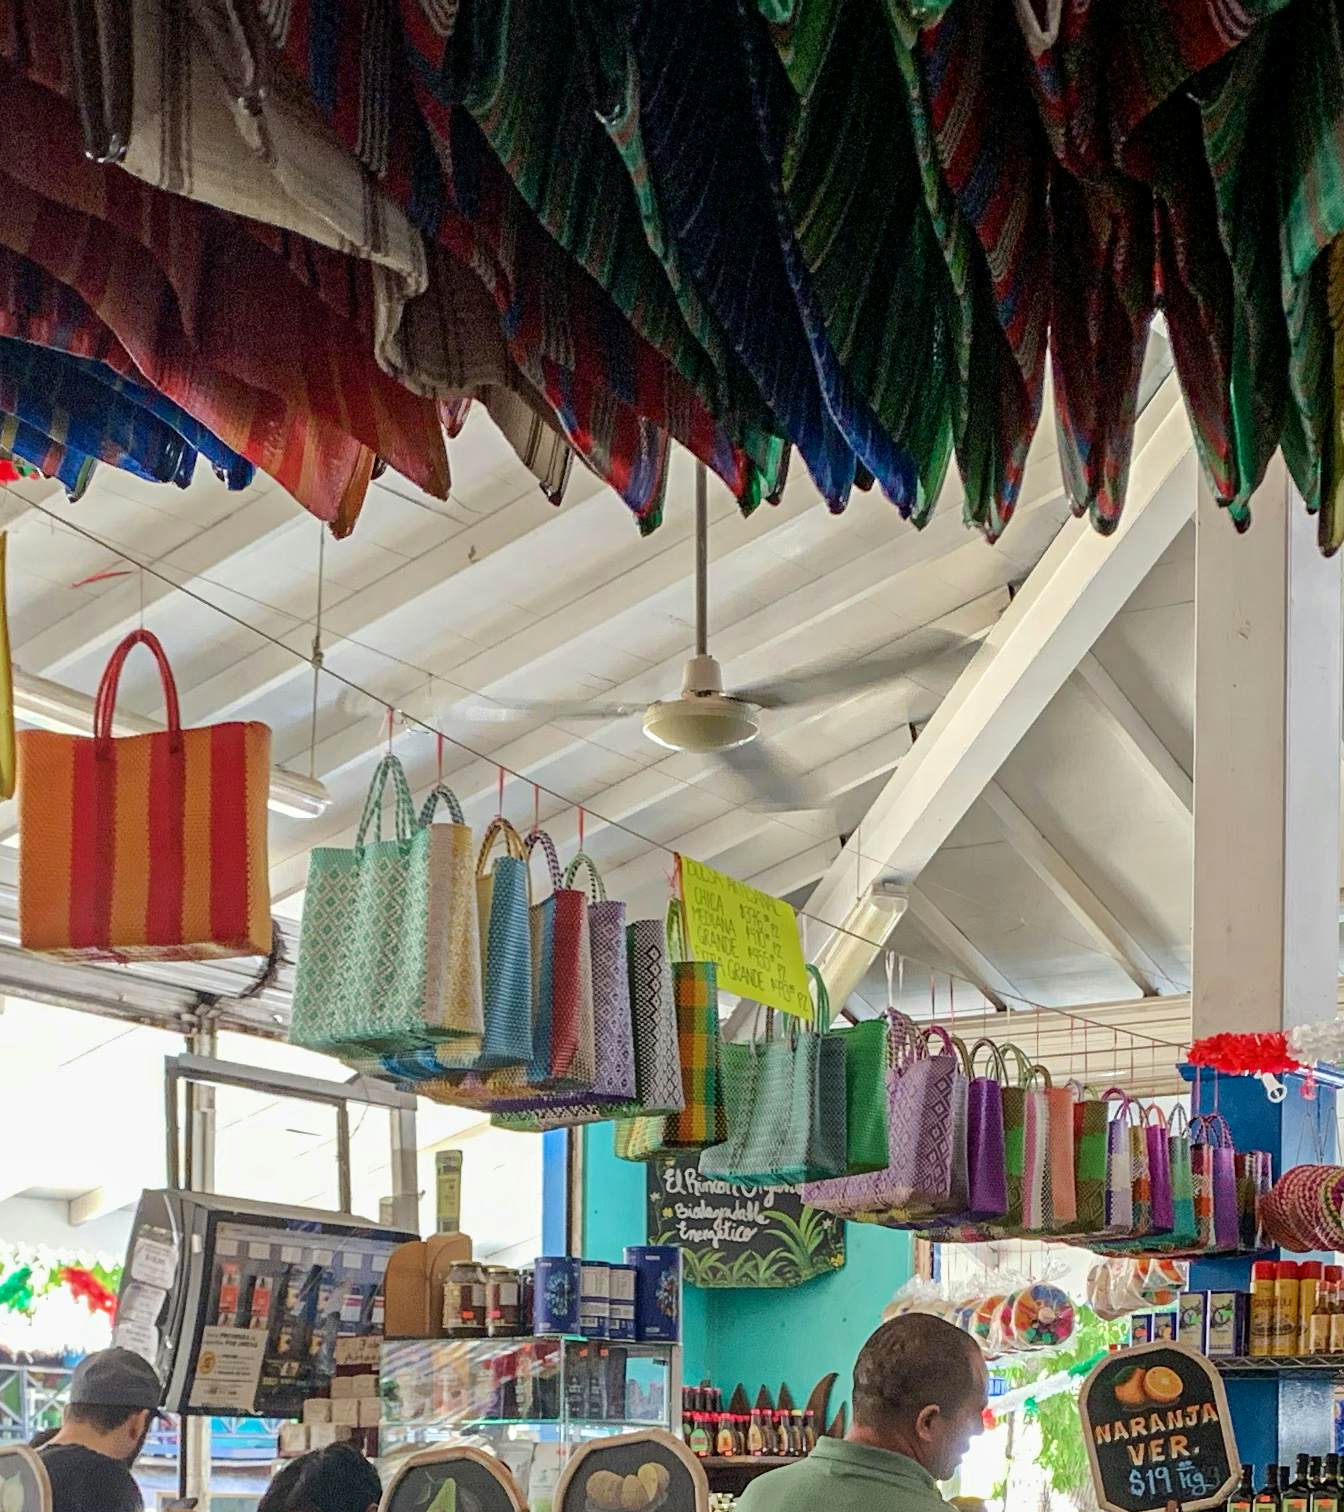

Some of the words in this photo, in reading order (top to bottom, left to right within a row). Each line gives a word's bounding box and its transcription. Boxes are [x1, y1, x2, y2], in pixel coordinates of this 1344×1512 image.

[694, 886, 725, 916] CHICA
[697, 926, 739, 959] GRANDE
[727, 958, 765, 991] GRANDE
[663, 1167, 688, 1195] El
[1096, 1402, 1219, 1444] NARANJA
